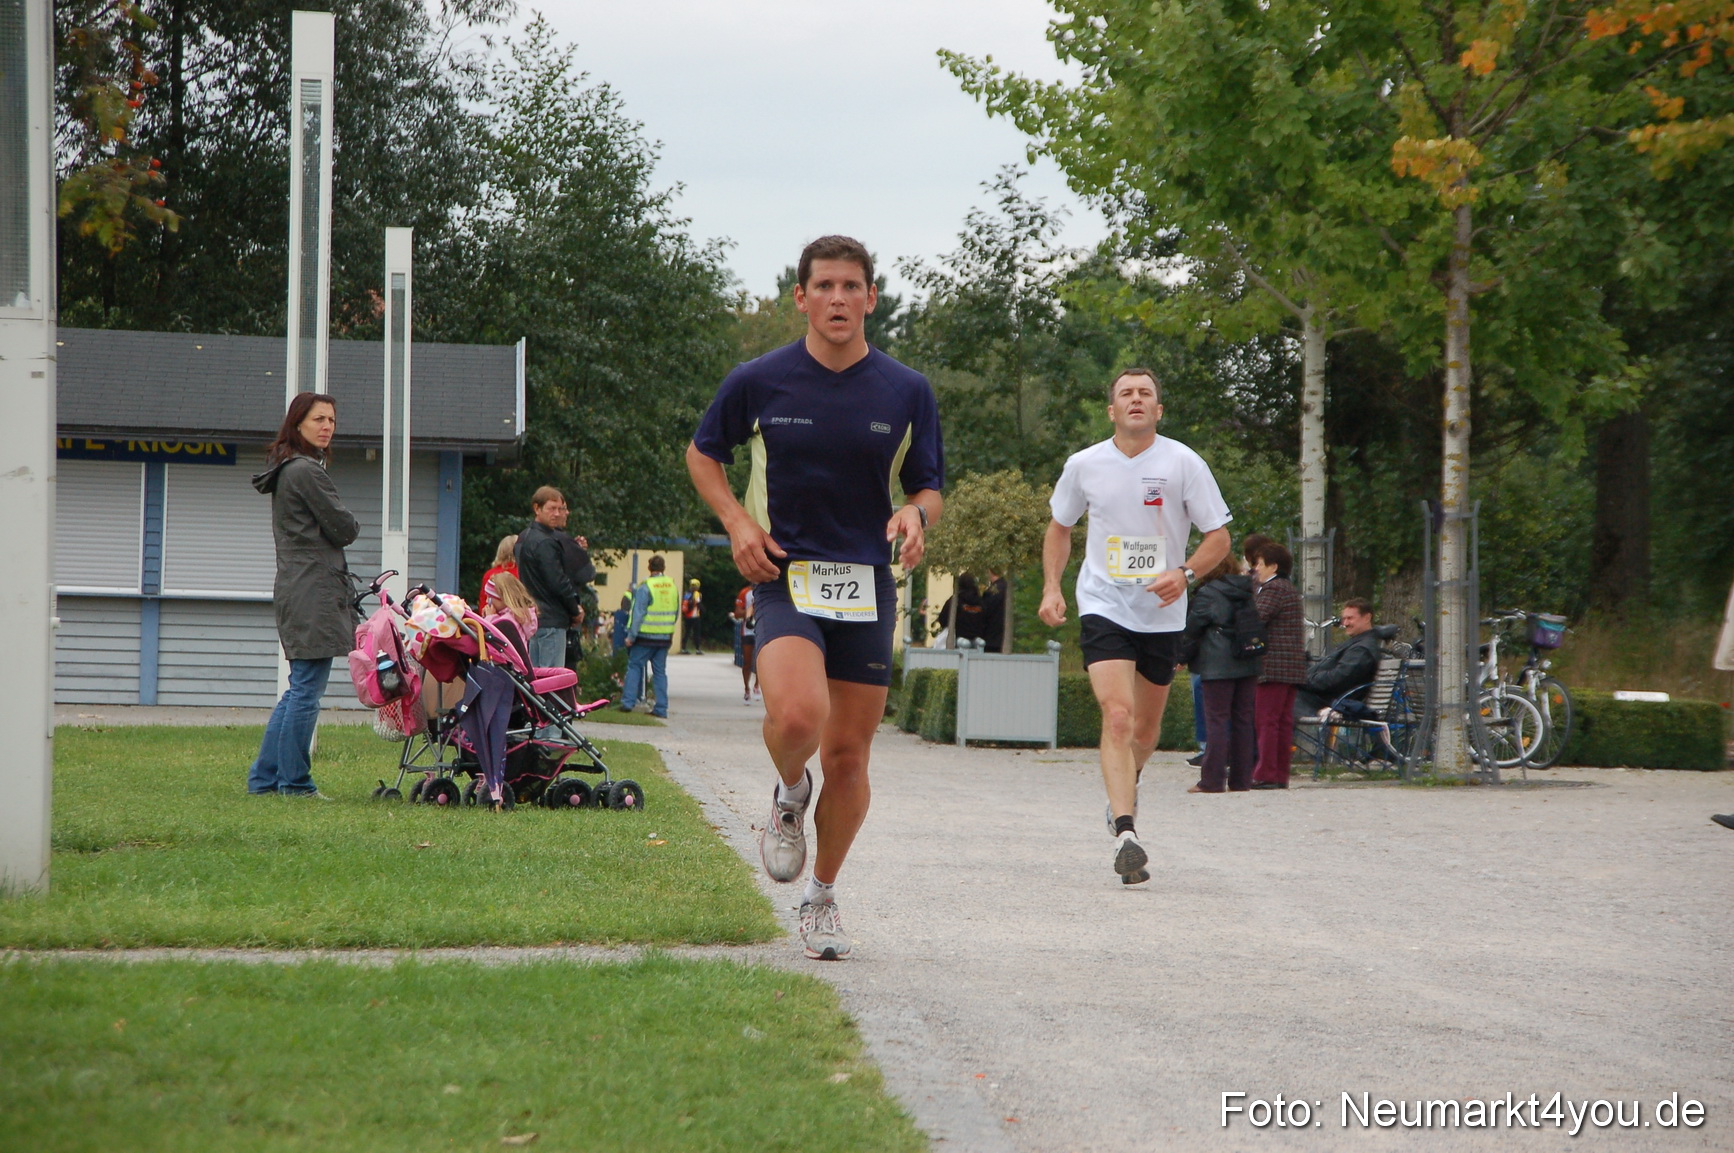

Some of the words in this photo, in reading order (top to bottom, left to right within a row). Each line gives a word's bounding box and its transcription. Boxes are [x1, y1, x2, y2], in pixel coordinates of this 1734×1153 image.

[1123, 541, 1158, 552] Wolfgang
[1128, 555, 1155, 569] 200
[812, 563, 852, 576] Markus
[820, 580, 860, 600] 572
